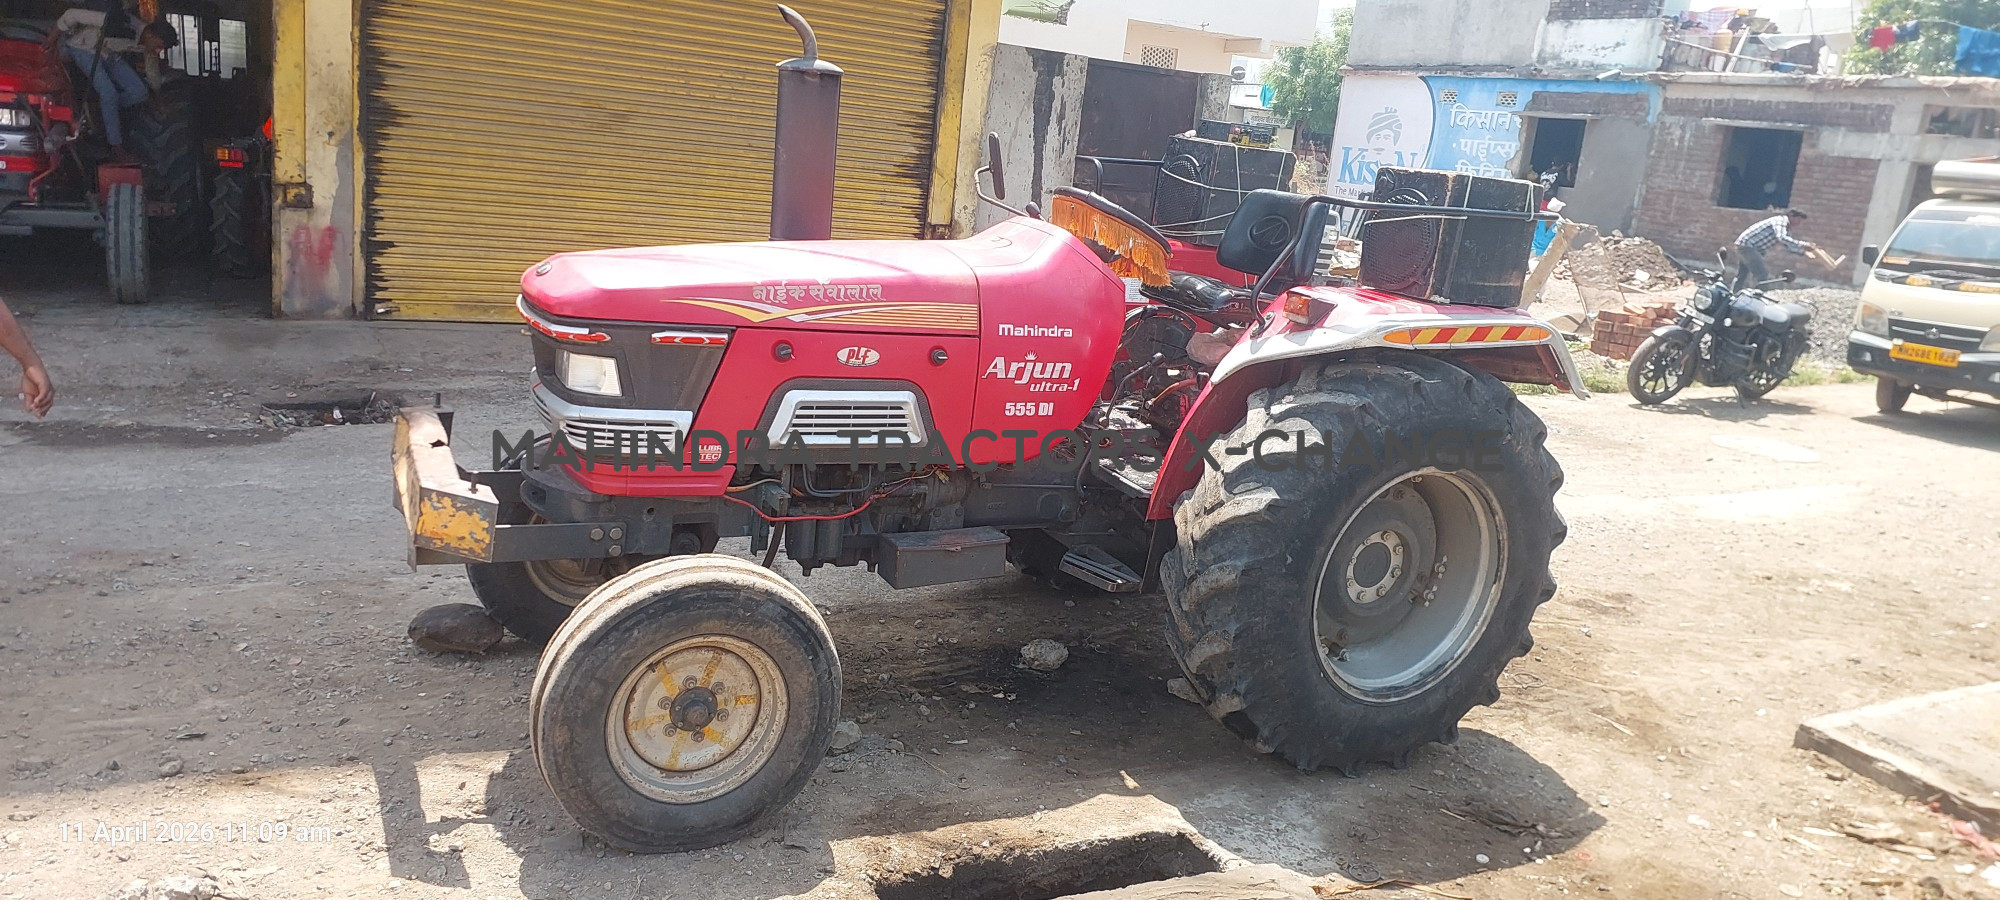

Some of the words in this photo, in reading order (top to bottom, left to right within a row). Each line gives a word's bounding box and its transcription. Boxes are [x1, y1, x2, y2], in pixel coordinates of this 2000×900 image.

[998, 323, 1073, 338] Mahindra
[981, 352, 1073, 385] Arjun
[1029, 377, 1081, 392] ultra-1
[1004, 402, 1036, 416] 555
[1037, 402, 1054, 416] DI
